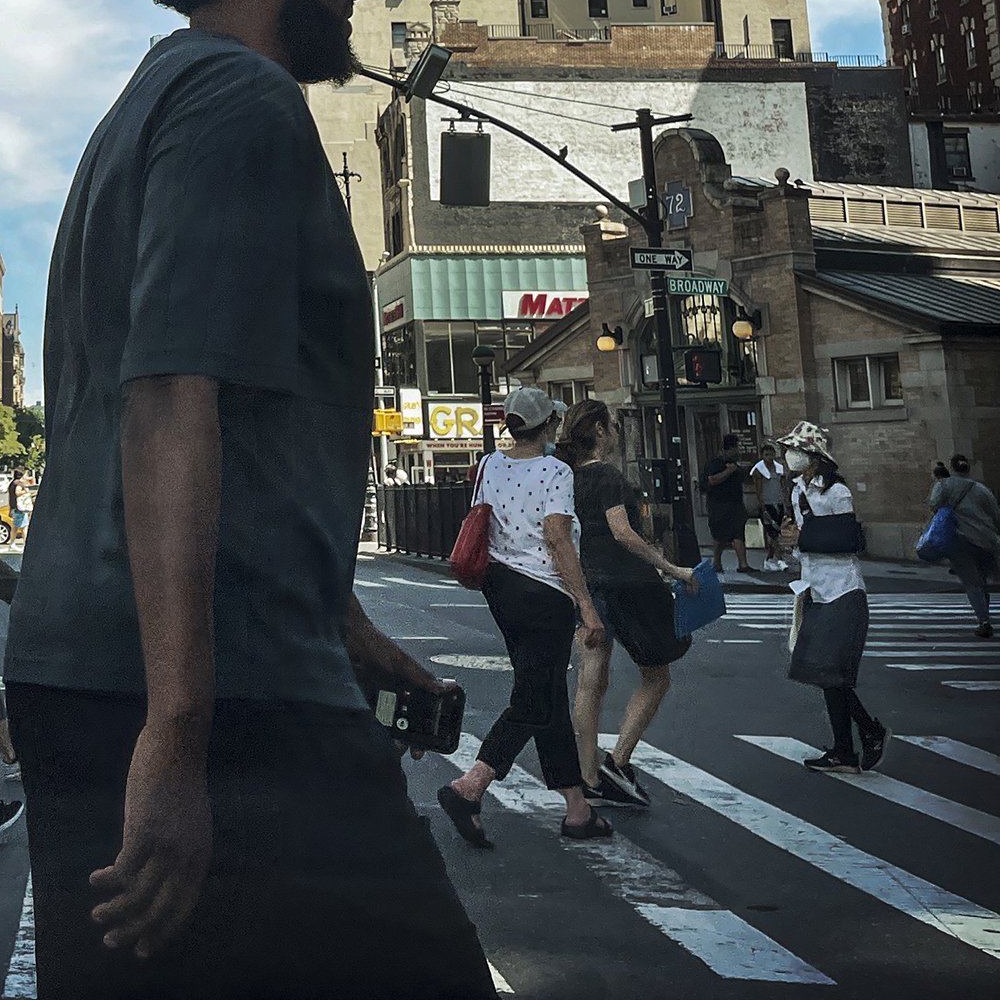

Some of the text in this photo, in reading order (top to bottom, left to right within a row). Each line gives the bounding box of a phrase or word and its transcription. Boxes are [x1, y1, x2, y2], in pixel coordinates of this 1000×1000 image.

[665, 192, 687, 215] 72
[639, 254, 684, 265] ONE WAY
[669, 278, 725, 294] BROADWAY
[430, 405, 483, 436] GR
